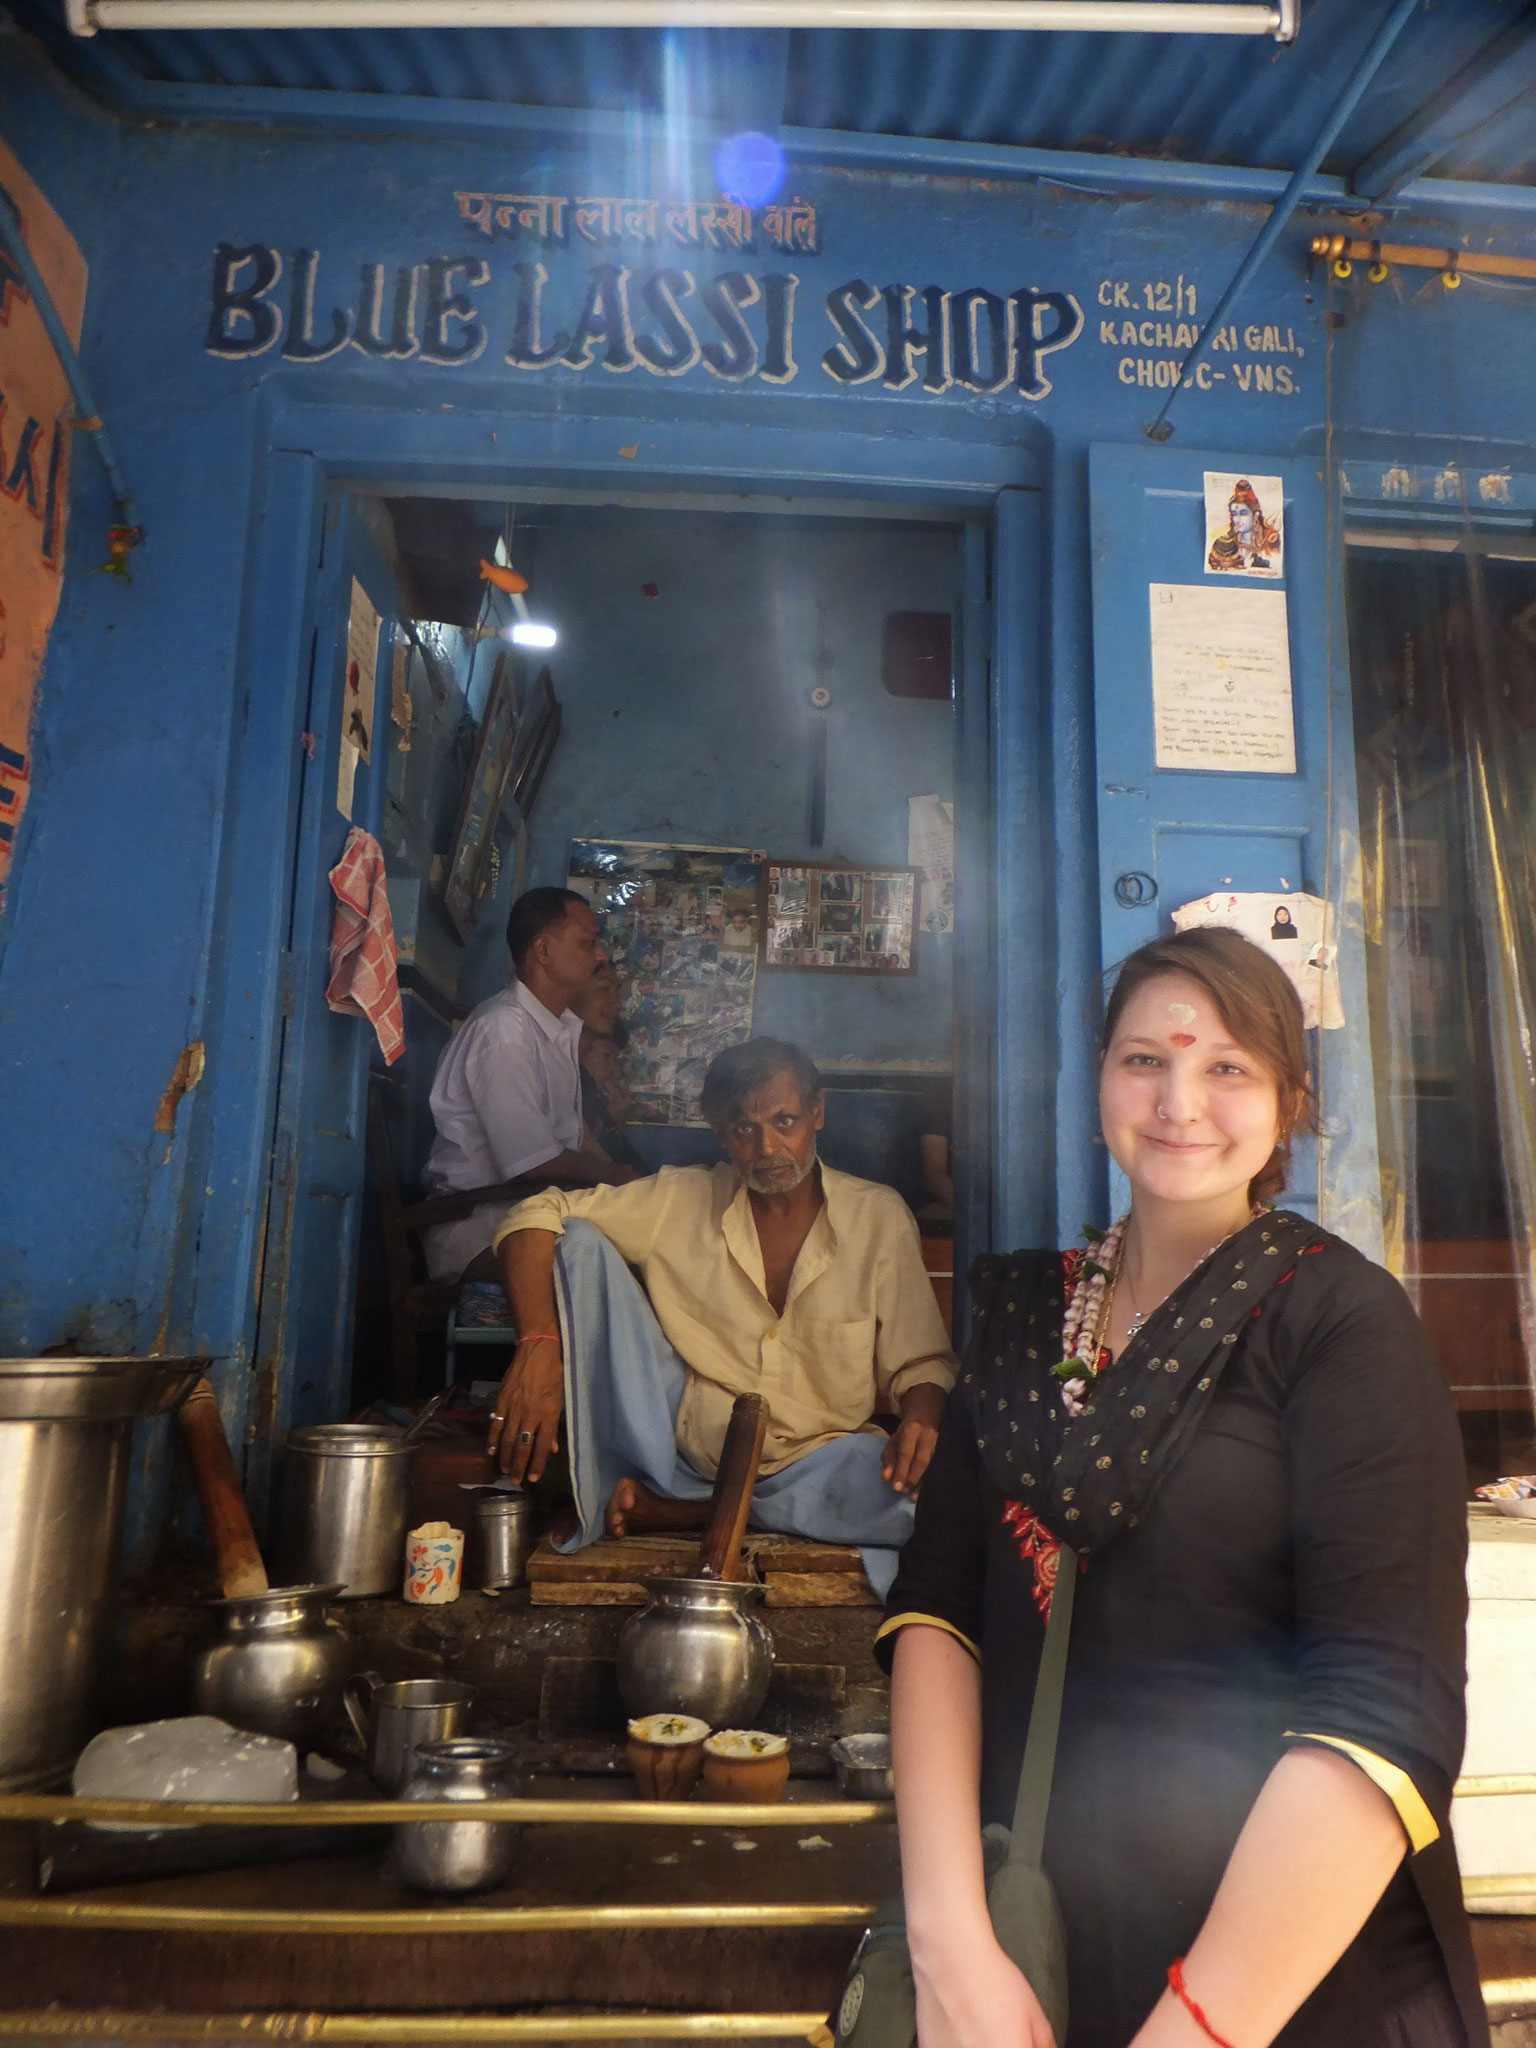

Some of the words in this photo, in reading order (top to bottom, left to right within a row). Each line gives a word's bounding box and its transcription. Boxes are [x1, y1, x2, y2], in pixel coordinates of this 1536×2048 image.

[453, 191, 568, 238] पन्ना
[575, 195, 659, 241] लाल
[205, 242, 490, 367] BLUE
[504, 261, 799, 386] LASSI
[821, 278, 1085, 401] SHOP
